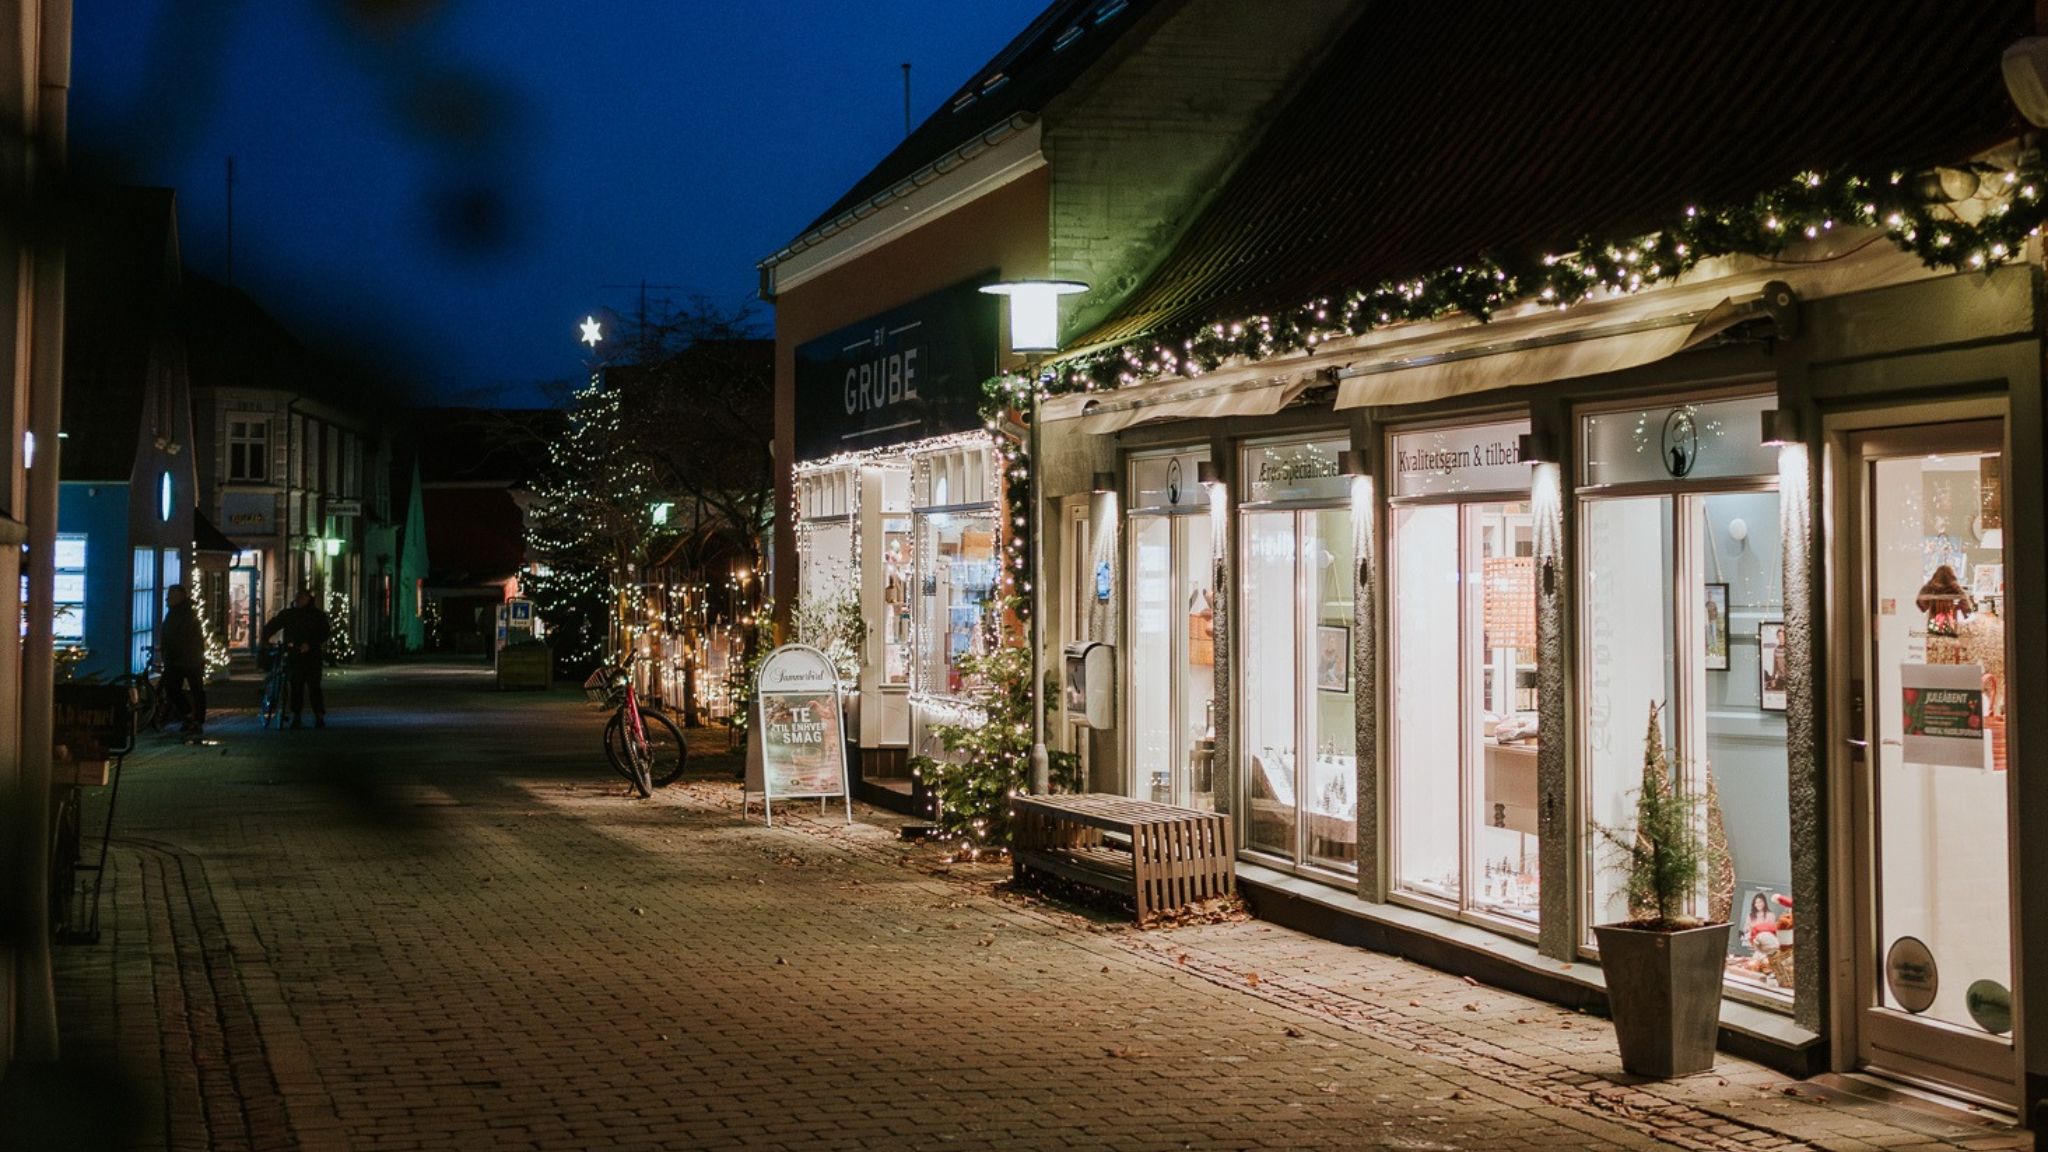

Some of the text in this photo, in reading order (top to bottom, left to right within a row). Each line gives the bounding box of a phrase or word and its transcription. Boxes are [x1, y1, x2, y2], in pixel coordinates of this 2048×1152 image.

[844, 348, 918, 416] GRUBE
[1398, 440, 1523, 475] Kvalitetsgarn & tilbeh
[1282, 459, 1338, 487] Specialitete
[789, 707, 811, 723] TE
[776, 722, 827, 732] TIL ENHVER
[782, 731, 822, 744] SMAG
